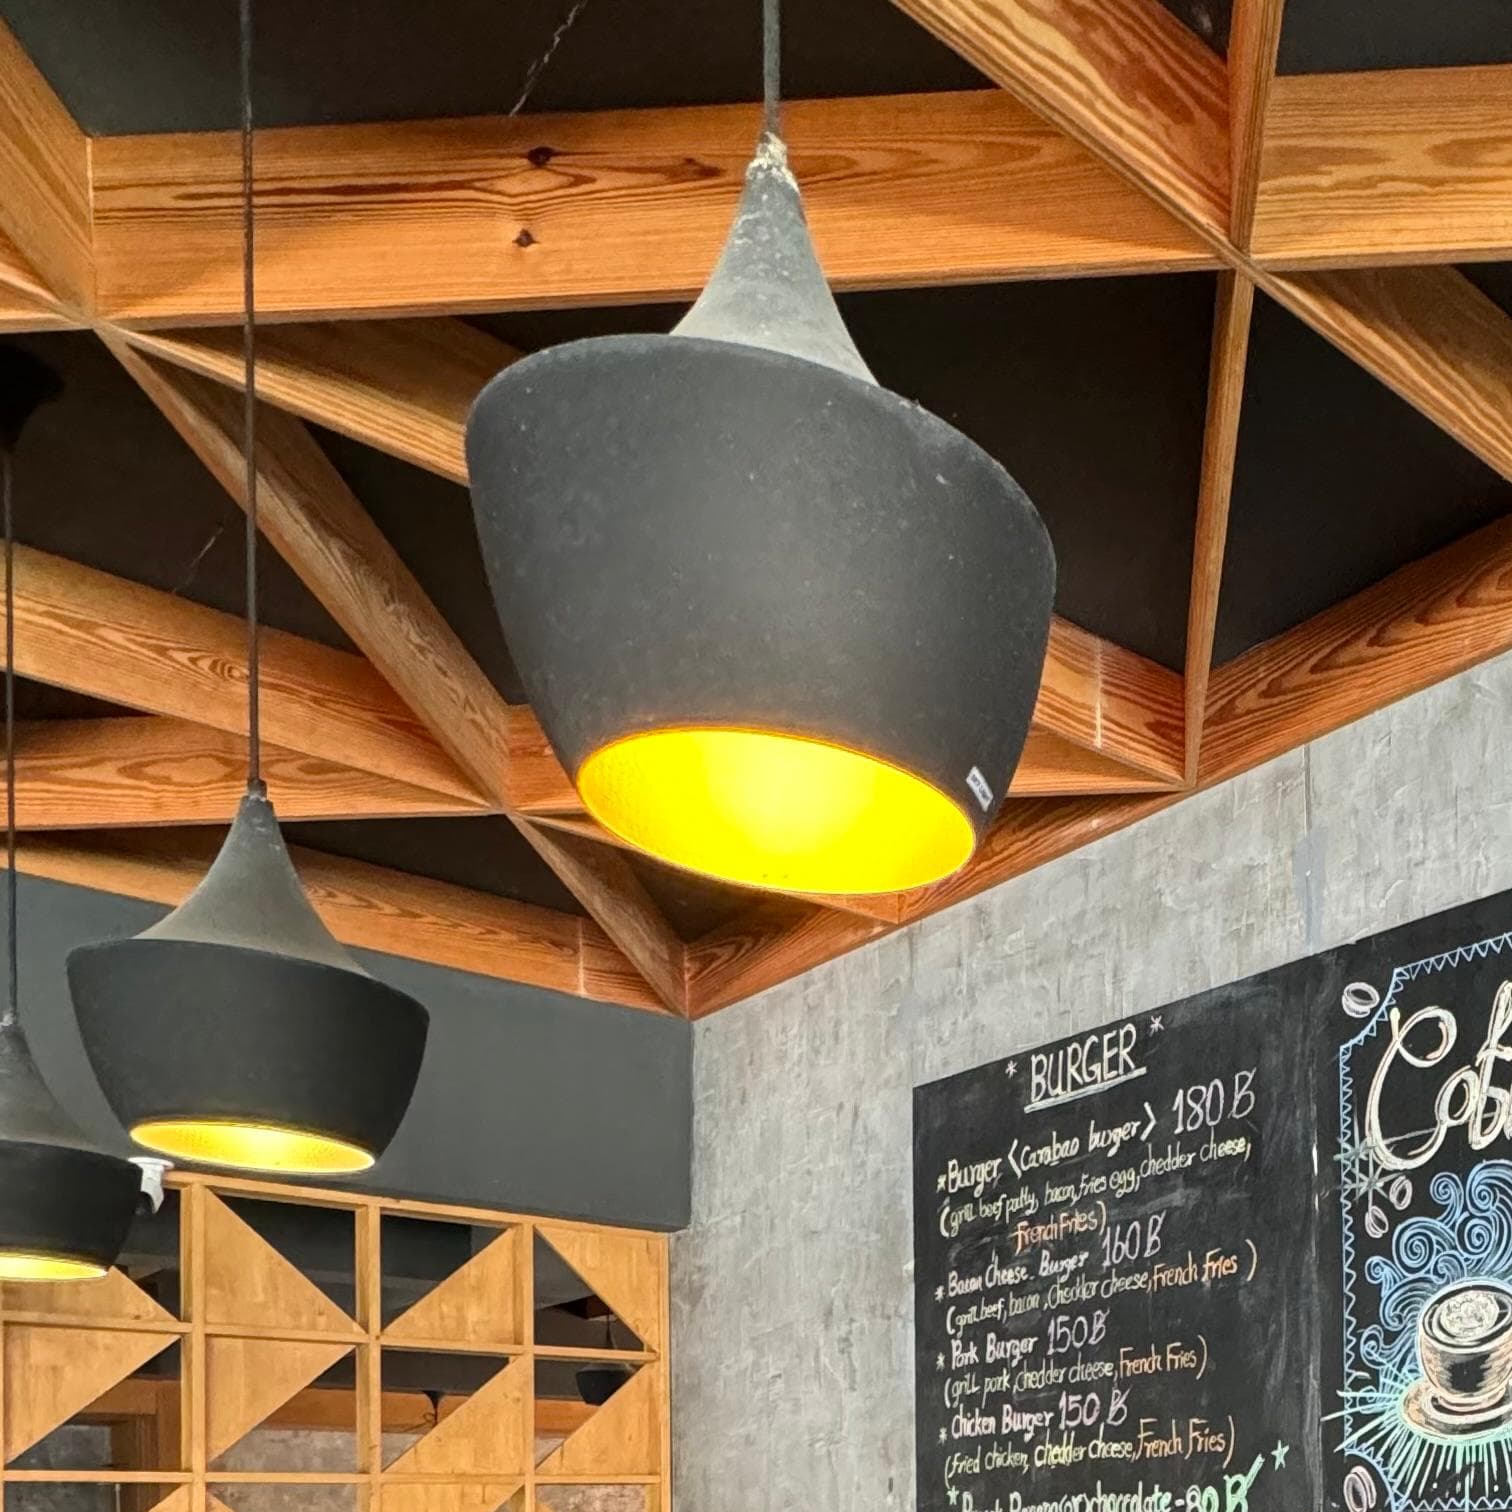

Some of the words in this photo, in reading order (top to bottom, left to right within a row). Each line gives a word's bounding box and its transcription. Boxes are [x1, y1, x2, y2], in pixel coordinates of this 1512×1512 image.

[1030, 1023, 1137, 1103] BURGER
[947, 1158, 1003, 1198] Burger
[948, 1270, 983, 1298] Bacon
[1039, 1250, 1090, 1284] Burger
[1153, 1250, 1198, 1291] French
[951, 1338, 980, 1370] Pork
[985, 1332, 1039, 1367] Burger
[1119, 1345, 1162, 1380] French
[1001, 1404, 1054, 1442] Burger
